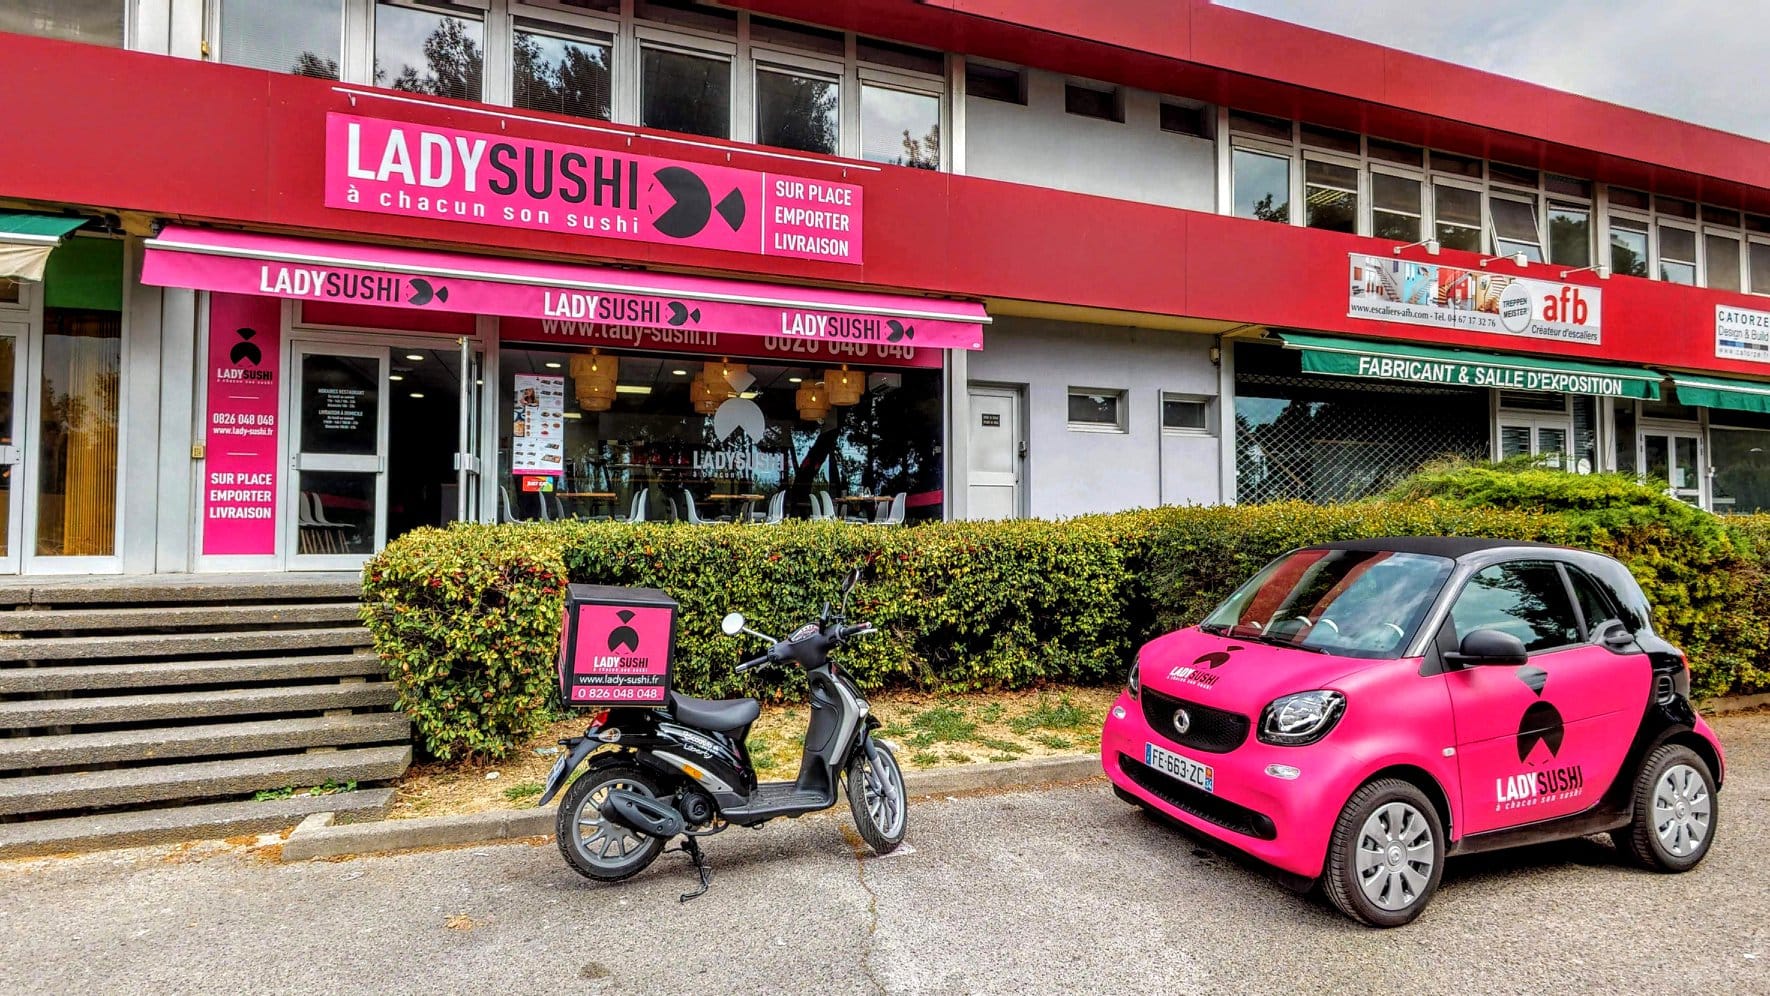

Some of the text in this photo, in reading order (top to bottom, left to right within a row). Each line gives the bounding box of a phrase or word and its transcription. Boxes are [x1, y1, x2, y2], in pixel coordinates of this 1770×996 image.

[347, 122, 638, 210] LADYSUSHI
[775, 180, 852, 206] SUR PLACE
[347, 184, 638, 234] à chacun son sushi
[775, 206, 849, 232] EMPORTER
[774, 232, 848, 257] LIVRAISON
[259, 265, 400, 302] LADYSUSHI
[544, 291, 660, 323] LADYSUSHI
[1351, 303, 1429, 320] www.escaliers-afb.com
[1447, 315, 1456, 323] 04
[1458, 315, 1467, 324] 67
[1468, 316, 1476, 325] 17
[1478, 317, 1486, 327] 32
[1487, 318, 1496, 327] 76
[1503, 298, 1528, 308] TREPPEN
[1543, 286, 1588, 325] afb
[781, 312, 880, 340] LADYSUSHI
[1718, 310, 1769, 328] CATORZE
[1531, 325, 1598, 341] Créateur d'escaliers
[1718, 326, 1769, 341] Design & Build
[1358, 356, 1623, 395] FABRICANT & SALLE D'EXPOSITION
[213, 413, 274, 425] 0826 048 048
[213, 426, 273, 436] www.lady-sushi.fr
[211, 472, 272, 485] SUR PLACE
[210, 490, 271, 502] EMPORTER
[209, 506, 271, 519] LIVRAISON
[579, 674, 660, 686] www.lady-sushi.fr
[578, 688, 657, 698] 0 826 048 048
[1152, 749, 1204, 786] FE-663-ZC
[1496, 765, 1583, 802] LADYSUSHI
